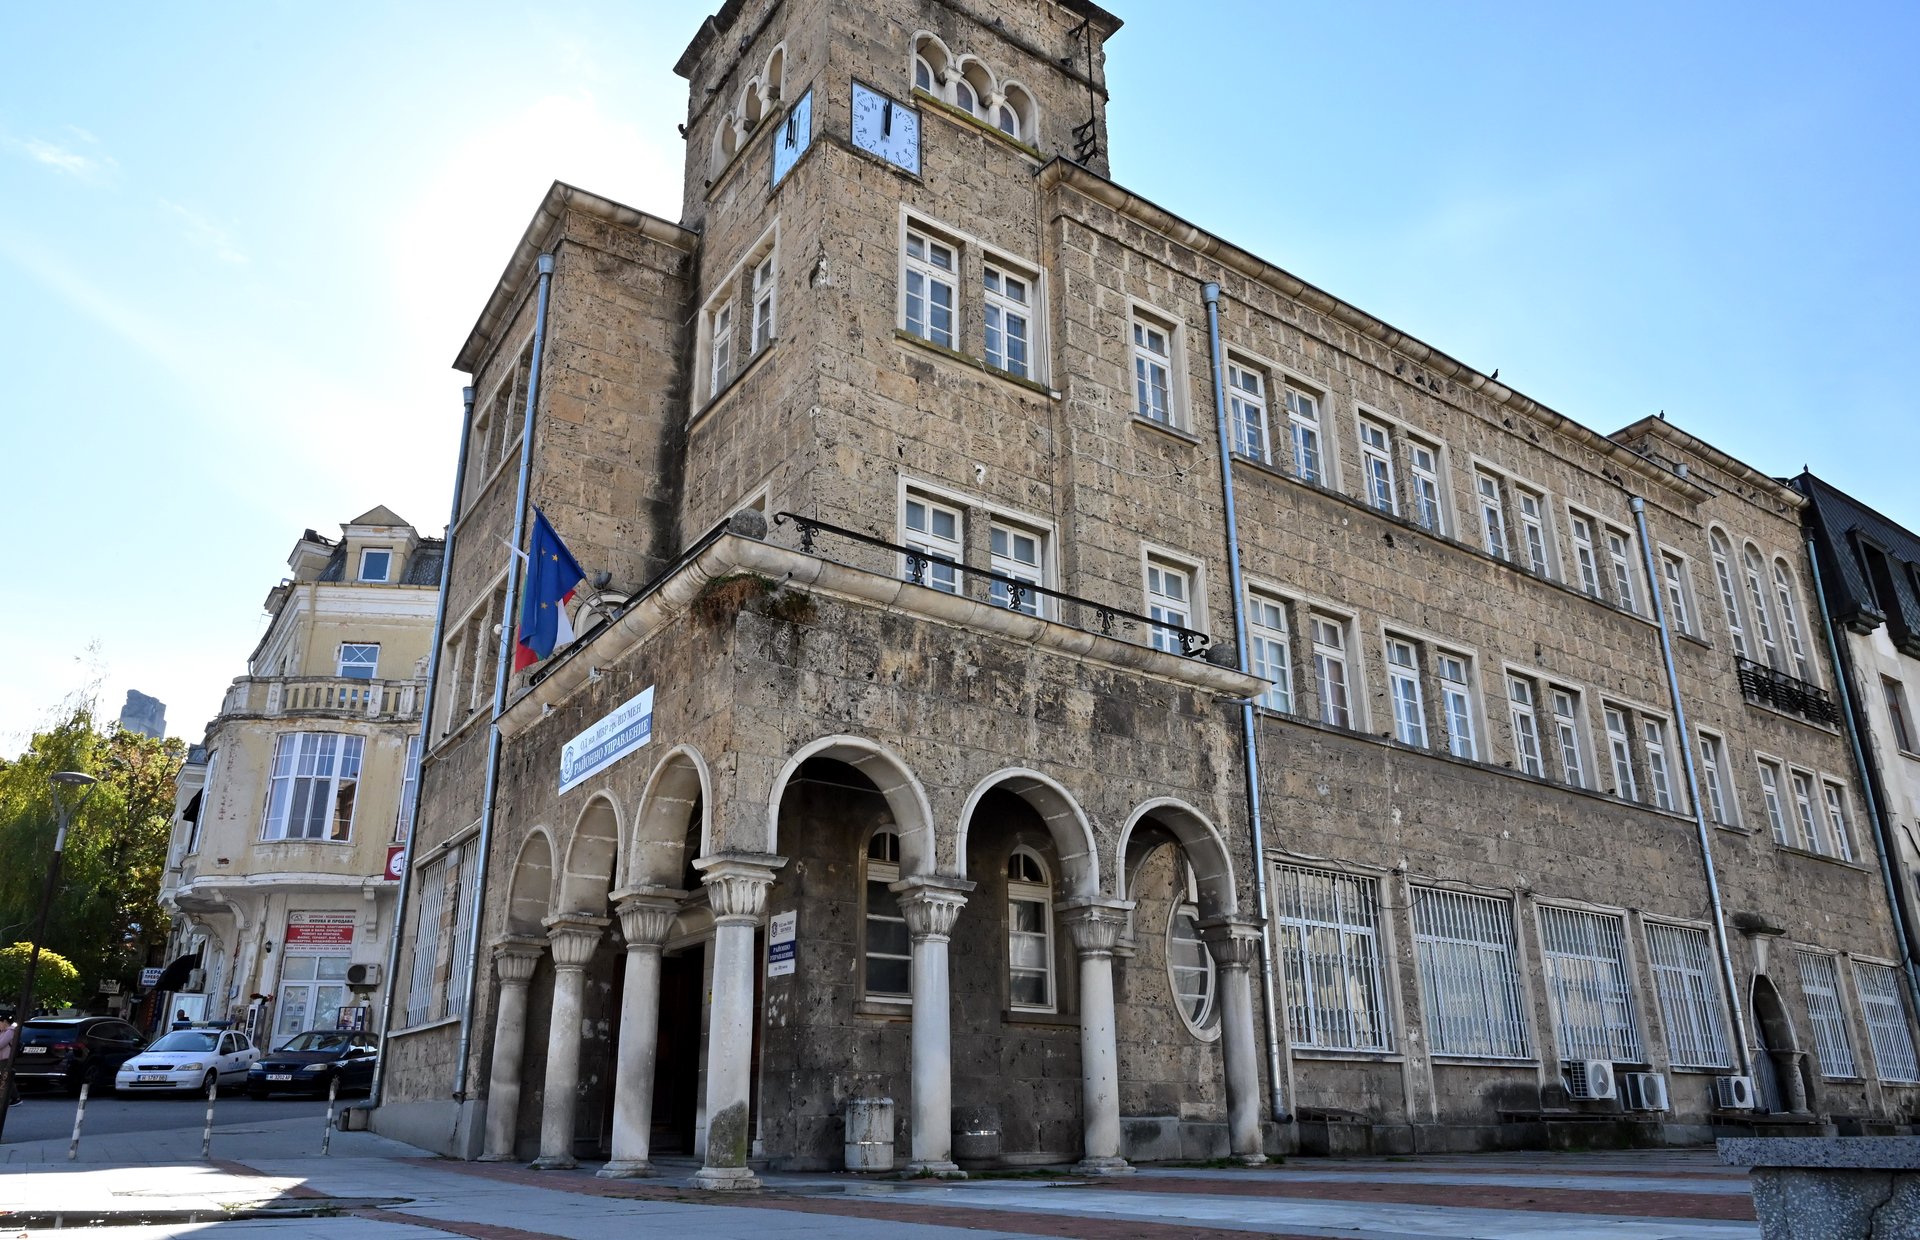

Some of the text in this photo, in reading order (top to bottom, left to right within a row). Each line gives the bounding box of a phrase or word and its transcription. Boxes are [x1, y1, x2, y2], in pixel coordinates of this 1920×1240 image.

[596, 725, 608, 740] МВР
[618, 702, 642, 726] ШУМЕН
[574, 718, 648, 775] РАЙОННО УПРАВЛЕНИЕ
